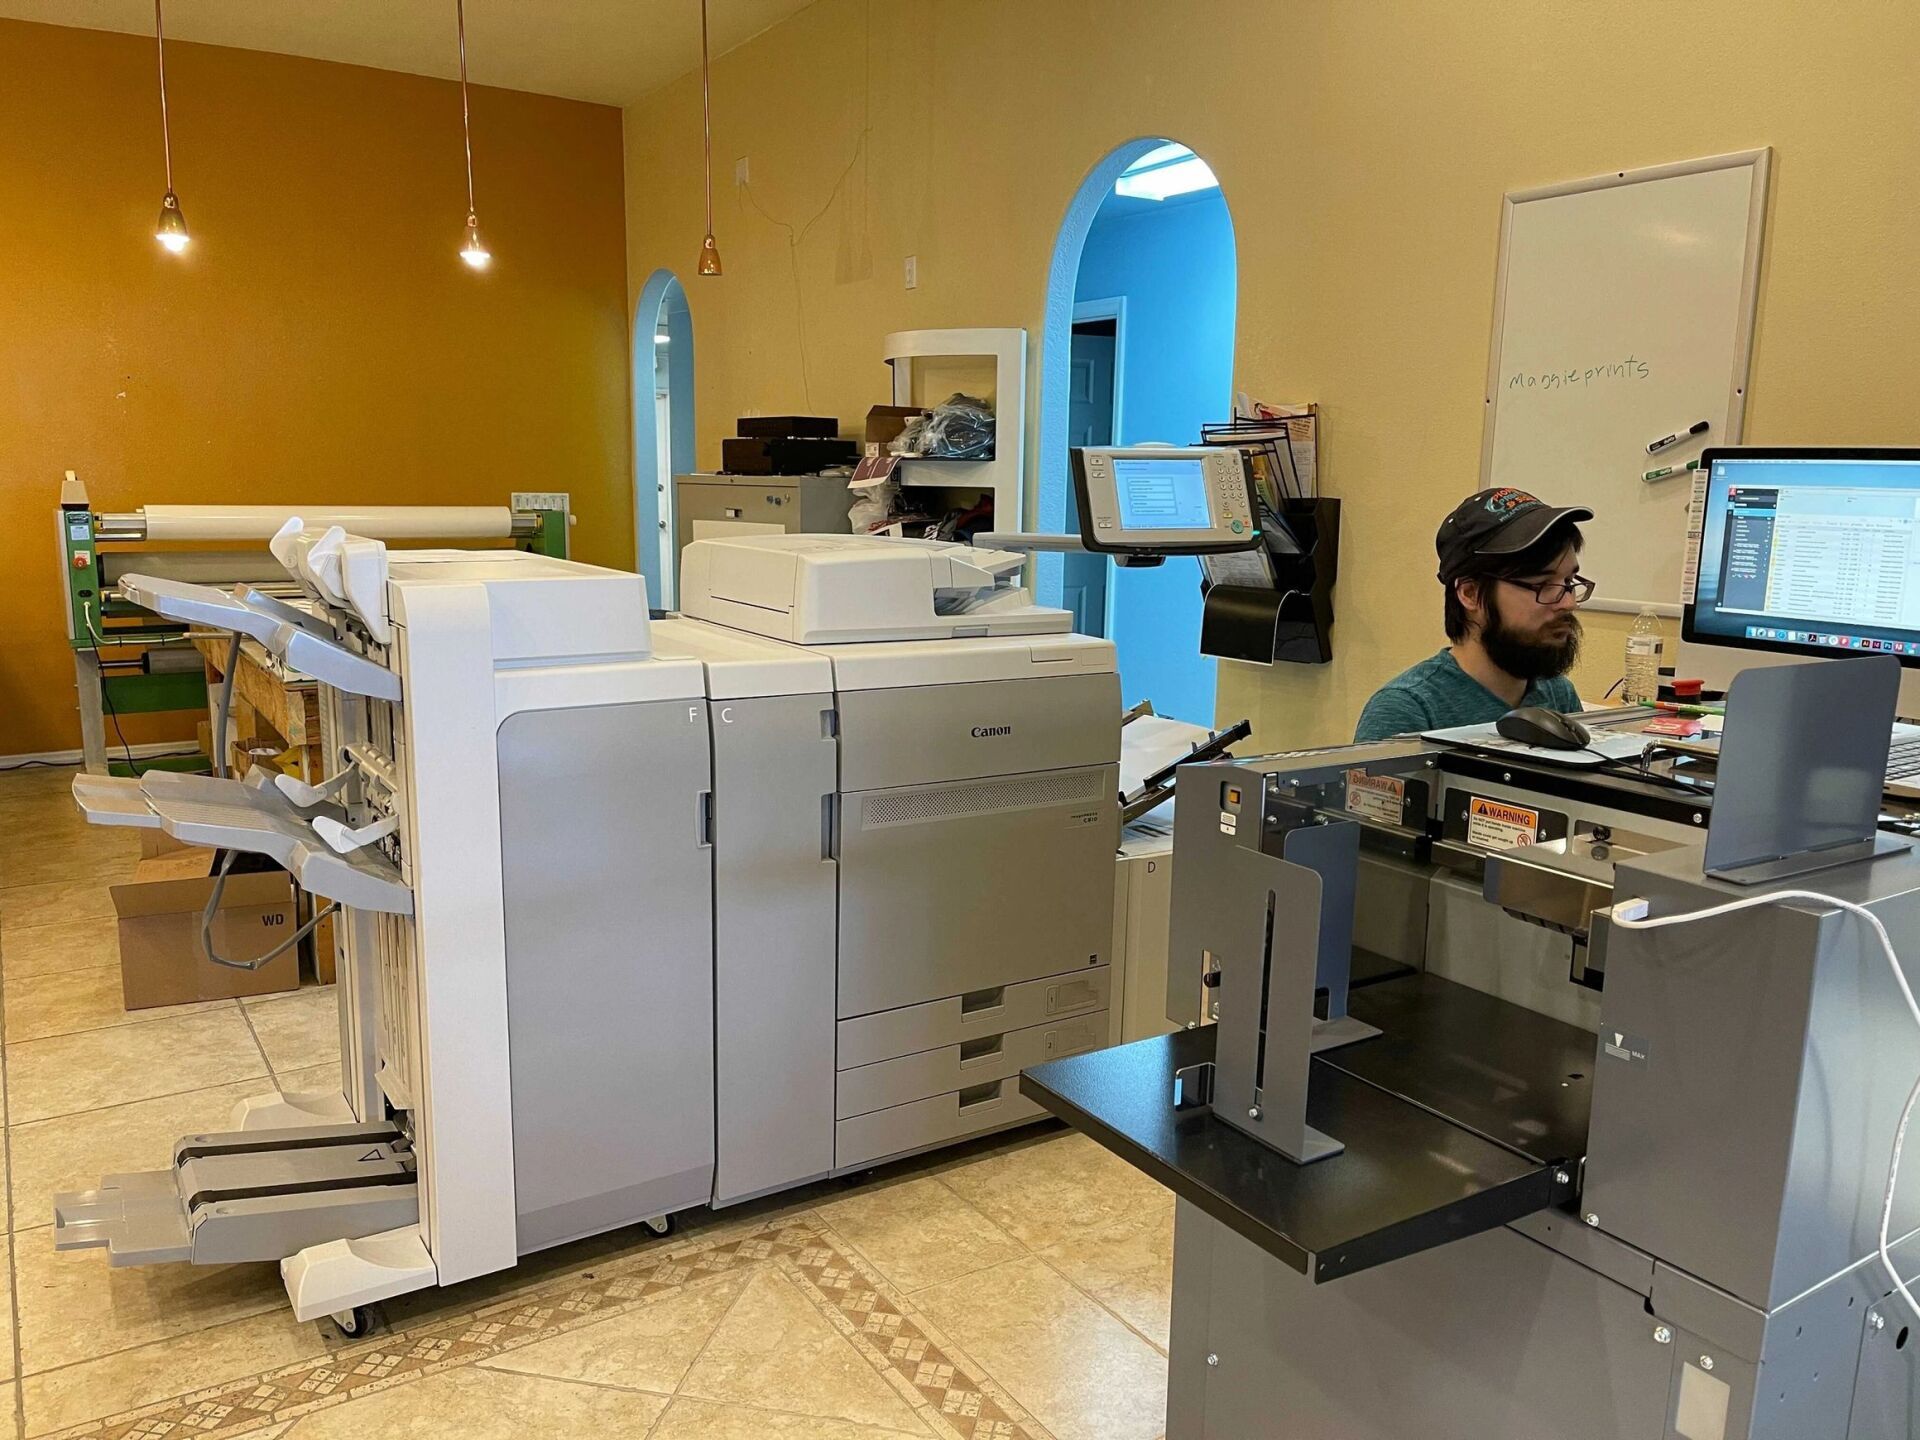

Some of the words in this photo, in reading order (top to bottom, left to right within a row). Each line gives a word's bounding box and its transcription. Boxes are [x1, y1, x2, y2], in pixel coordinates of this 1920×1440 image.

[689, 707, 697, 723] F
[721, 707, 733, 723] C
[971, 725, 1011, 738] Canon
[1489, 807, 1530, 825] WARNING
[1147, 861, 1156, 873] D
[262, 913, 284, 927] WD
